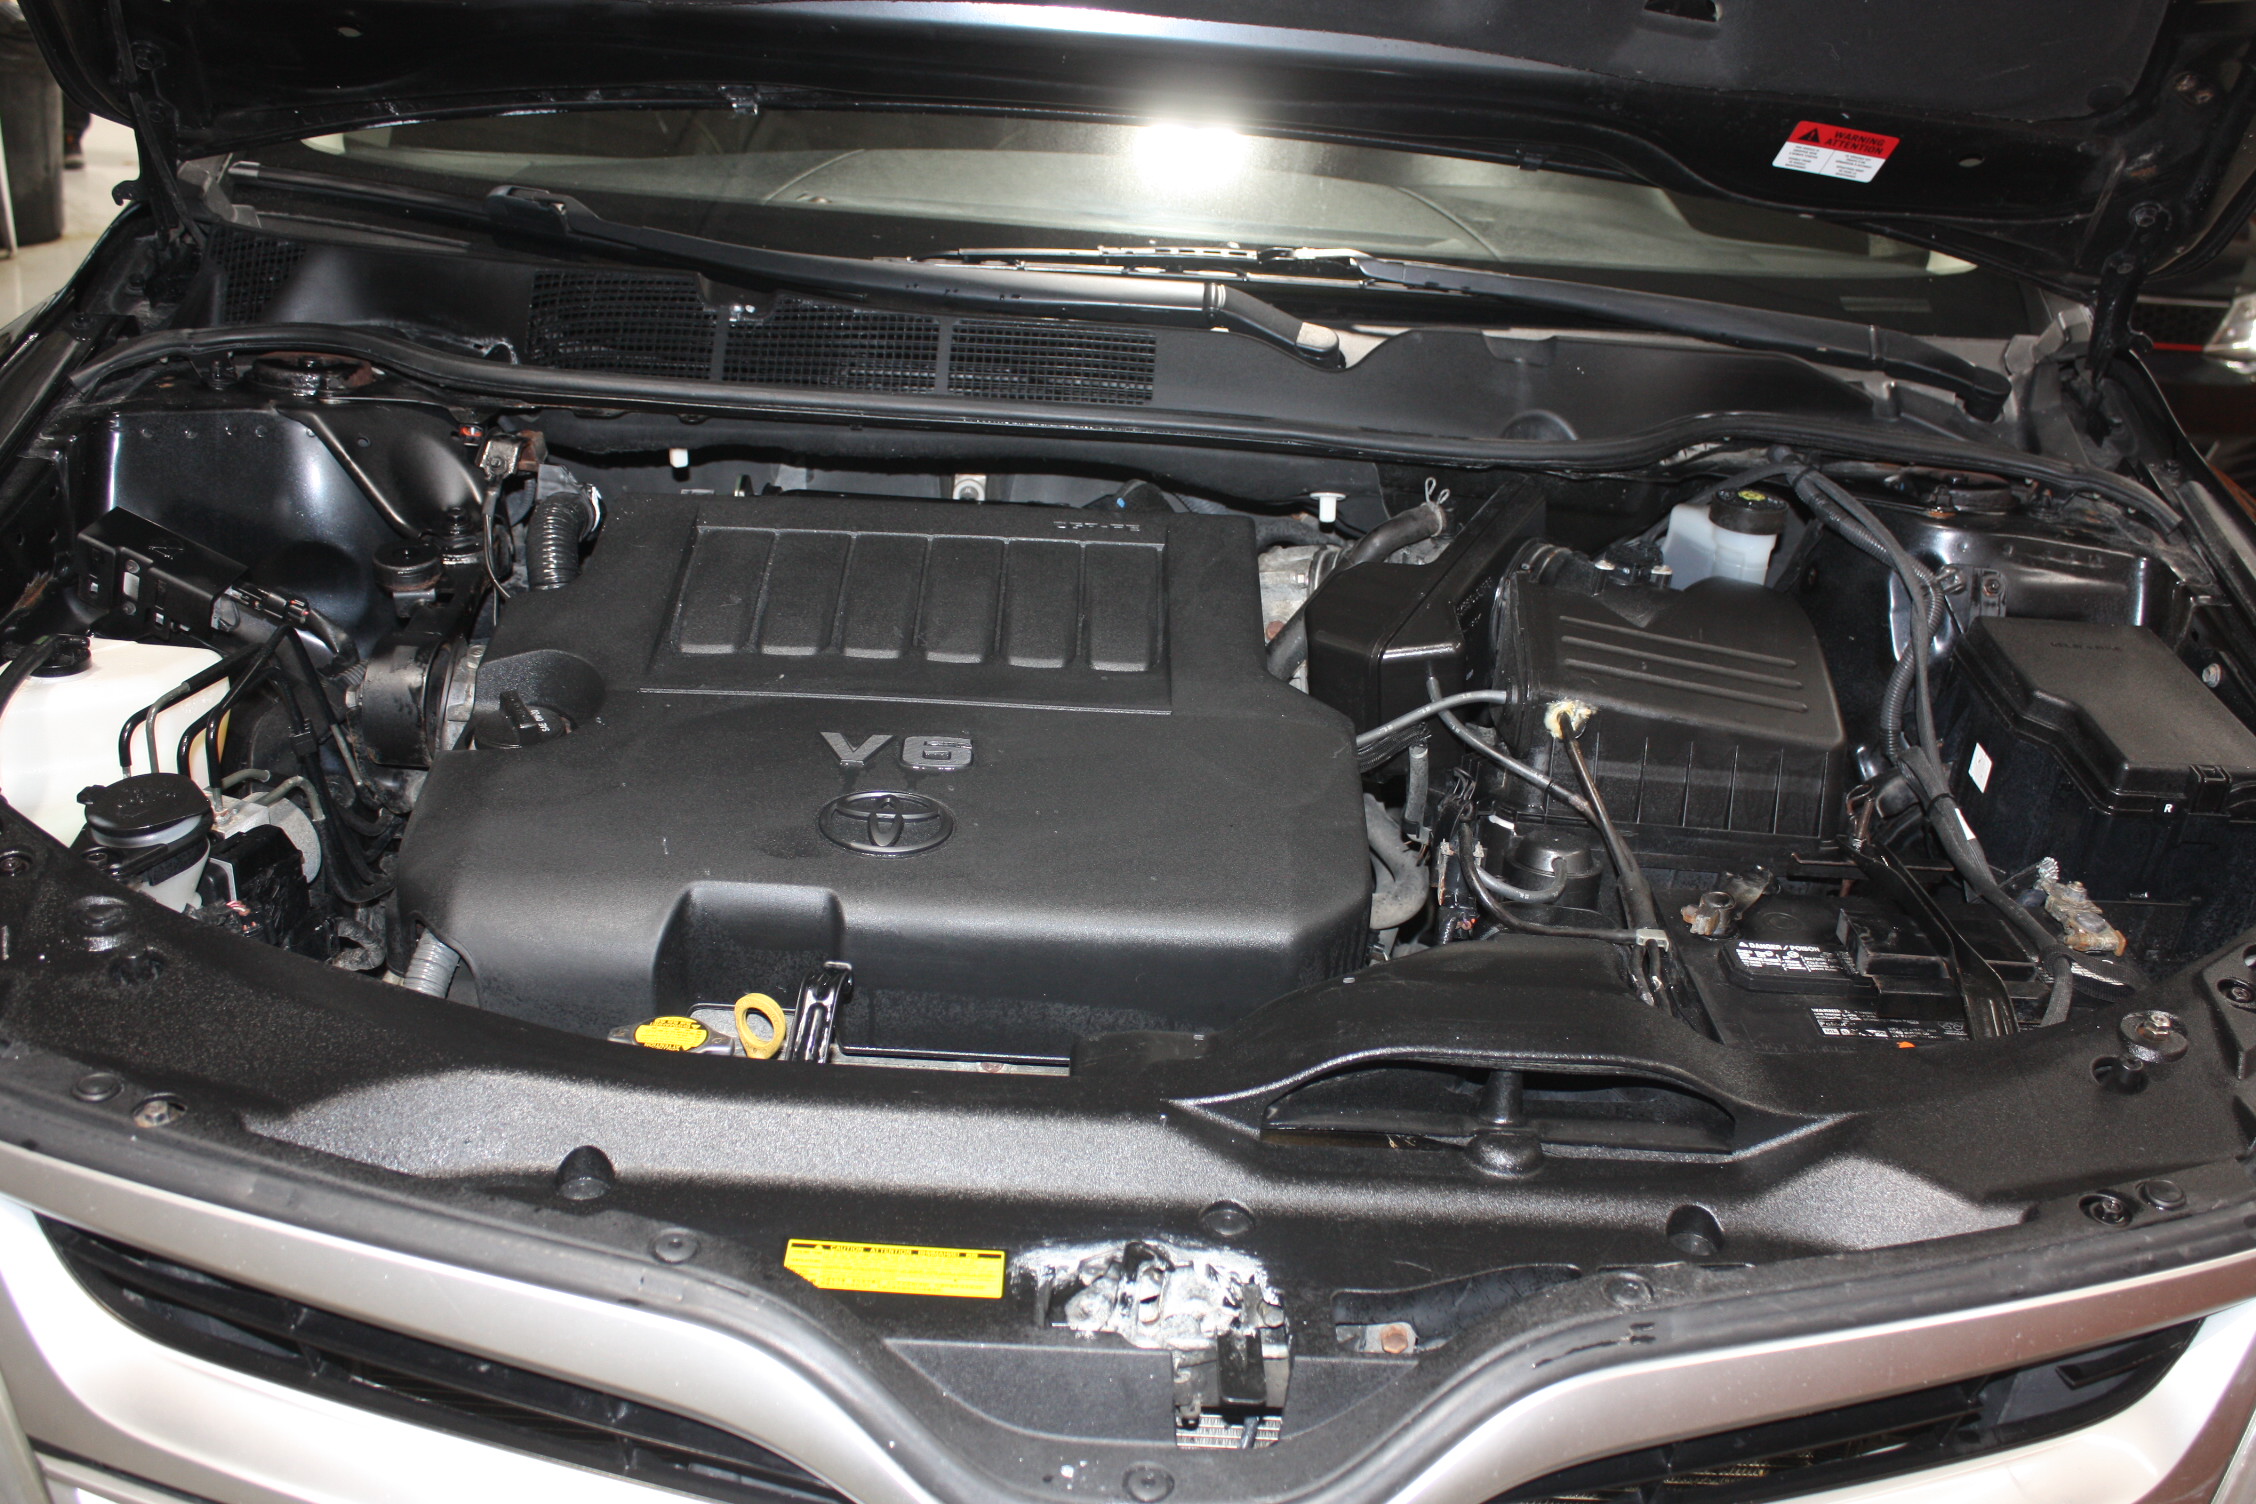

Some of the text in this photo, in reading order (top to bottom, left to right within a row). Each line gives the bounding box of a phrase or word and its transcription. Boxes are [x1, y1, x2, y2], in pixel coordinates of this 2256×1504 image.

[1834, 130, 1886, 147] WARNING
[1825, 138, 1884, 155] ATTENTION
[819, 731, 973, 771] V6
[2163, 803, 2173, 813] R
[1748, 942, 1783, 950] DANGER
[830, 1244, 865, 1253] CAUTION
[869, 1247, 912, 1256] ATTENTION
